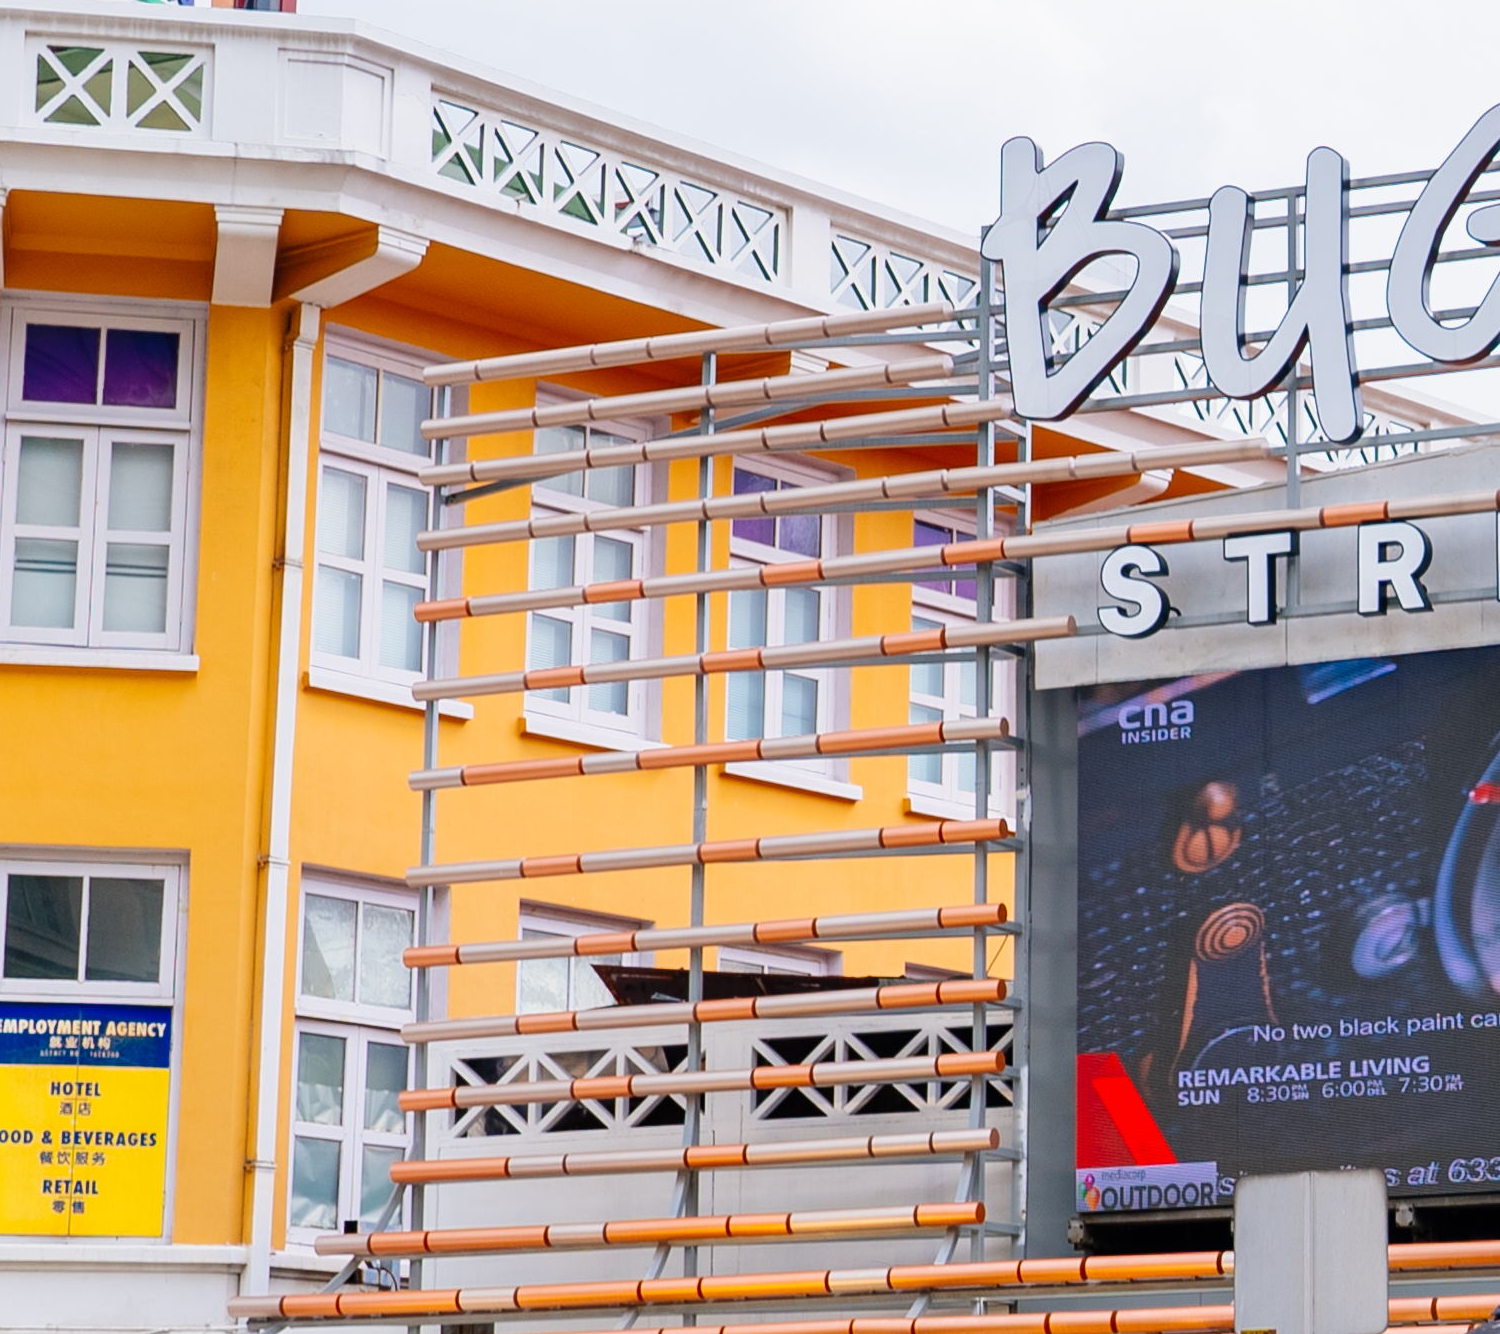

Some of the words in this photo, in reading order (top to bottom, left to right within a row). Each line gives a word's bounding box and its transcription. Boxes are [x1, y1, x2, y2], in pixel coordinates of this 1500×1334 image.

[1117, 698, 1195, 730] cna
[1120, 725, 1192, 745] INSIDER
[105, 1020, 167, 1038] AGENCY
[1253, 1024, 1286, 1043] No
[1292, 1021, 1333, 1039] two
[1339, 1015, 1400, 1038] black
[1406, 1012, 1465, 1037] paint
[1177, 1062, 1342, 1089] REMARKABLE
[1349, 1055, 1431, 1078] LIVING
[50, 1081, 102, 1097] HOTEL
[1178, 1089, 1221, 1107] SUN
[1246, 1085, 1291, 1104] 8:30
[1321, 1081, 1366, 1099] 6:00
[1399, 1076, 1443, 1094] 7:30
[59, 1101, 92, 1116] 酒店
[41, 1130, 53, 1144] &
[60, 1130, 157, 1147] BEVERAGES
[39, 1151, 106, 1166] 餐饮服务
[1406, 1164, 1440, 1186] at
[42, 1179, 99, 1195] RETAIL
[1101, 1182, 1216, 1211] OUTDOOR
[51, 1200, 86, 1214] 零售
